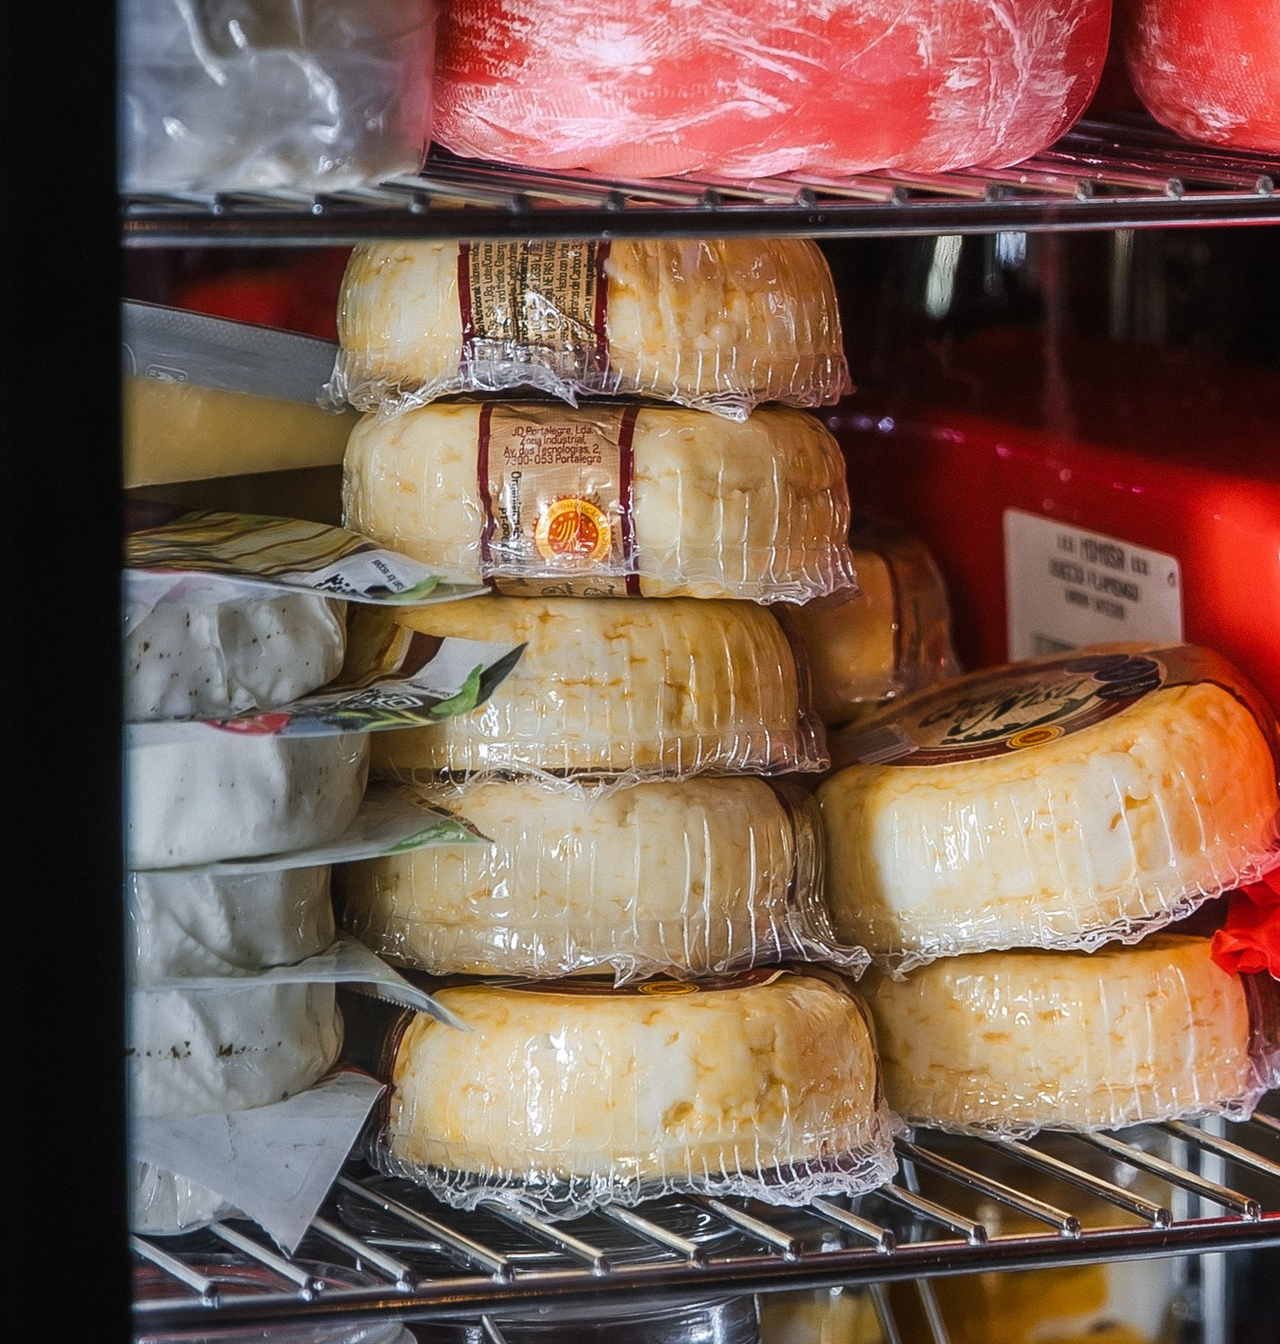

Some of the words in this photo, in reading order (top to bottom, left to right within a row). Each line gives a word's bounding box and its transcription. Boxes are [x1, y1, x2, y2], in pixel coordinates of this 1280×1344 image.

[510, 426, 524, 437] JD
[525, 425, 574, 437] Portalegre,
[542, 434, 586, 445] Industrial,
[502, 445, 517, 456] Av.
[536, 443, 591, 455] Tecnologias,
[555, 454, 602, 465] Portalegre
